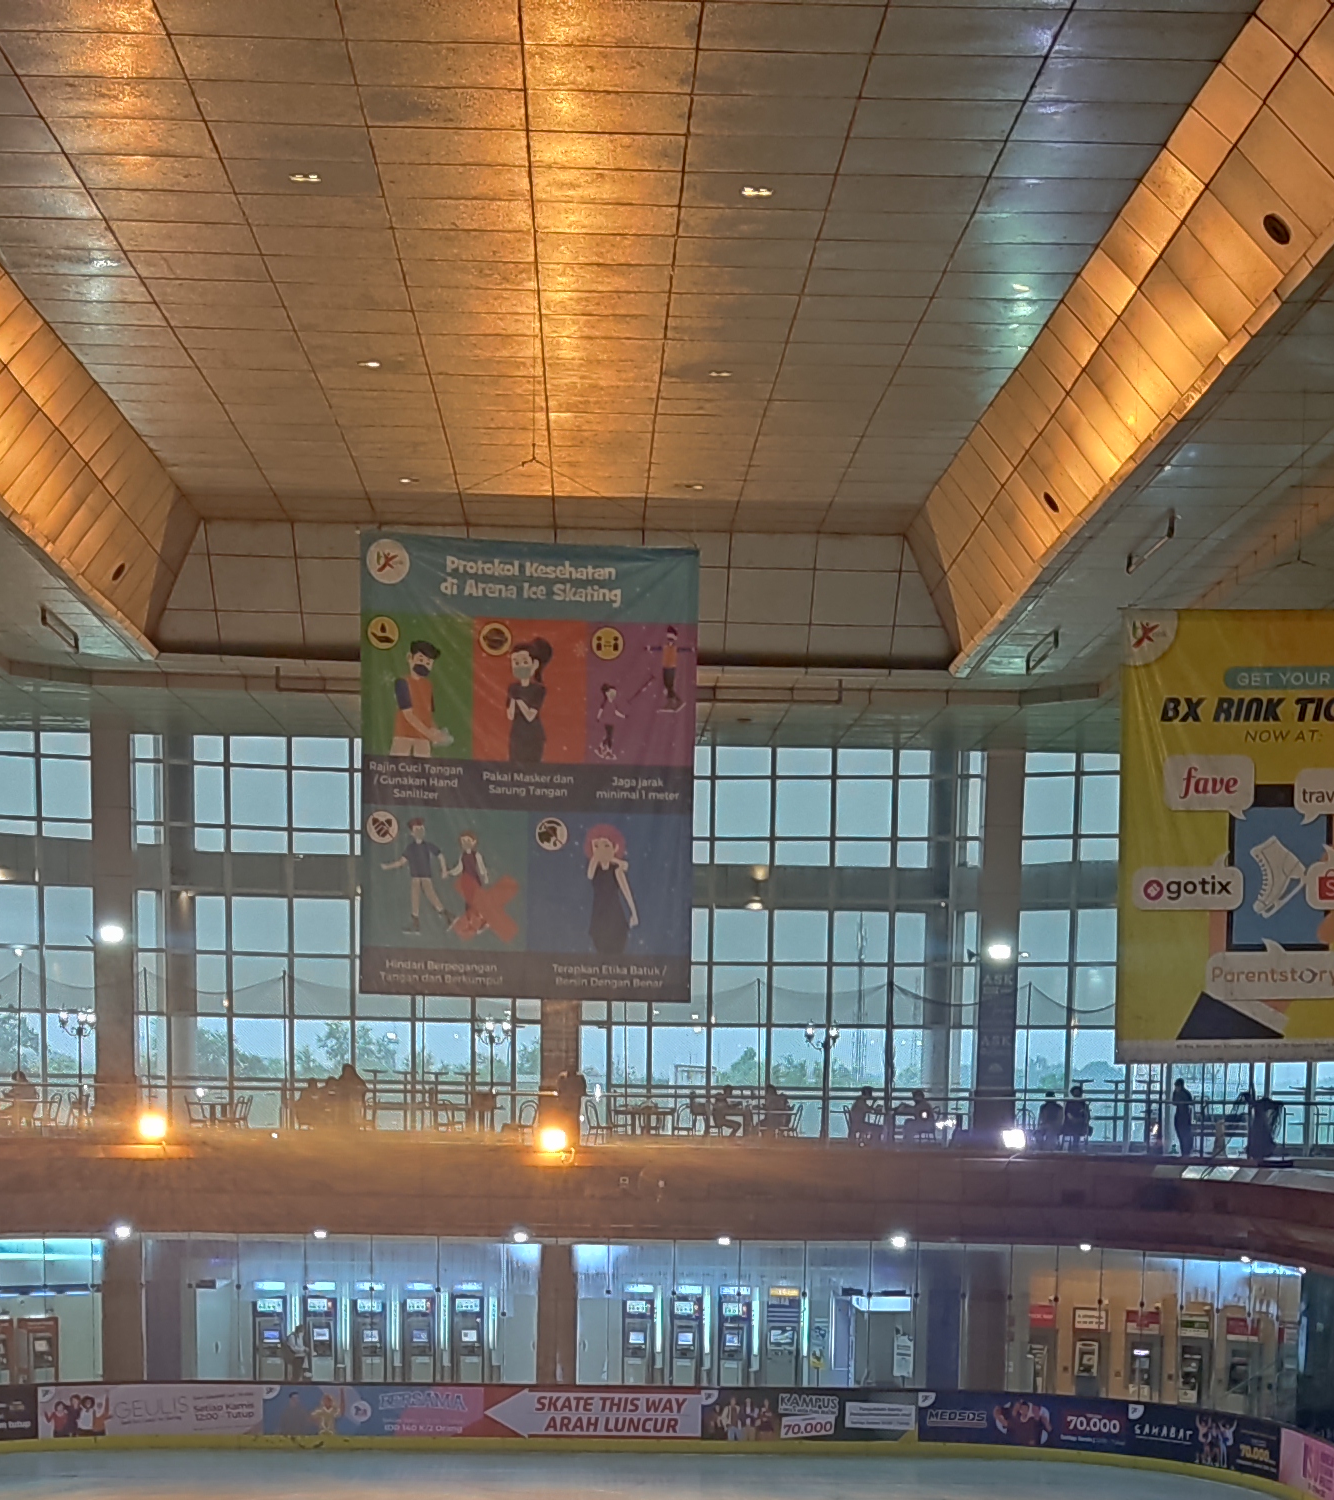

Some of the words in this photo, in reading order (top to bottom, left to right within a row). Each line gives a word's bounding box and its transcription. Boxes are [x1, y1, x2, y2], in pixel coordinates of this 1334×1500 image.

[445, 554, 520, 577] Protokol
[524, 561, 616, 580] Kesehatan
[440, 577, 458, 596] di
[464, 579, 517, 599] Arena
[523, 582, 546, 600] Ice
[552, 584, 622, 608] Skating
[1237, 672, 1274, 686] GET
[1279, 671, 1331, 686] YOUR
[1160, 695, 1207, 722] BX
[1212, 695, 1286, 722] RINK
[1244, 729, 1291, 743] NOW
[1294, 729, 1323, 742] AT:
[370, 761, 396, 775] Rajin
[398, 763, 421, 774] Cuci
[423, 764, 463, 777] Tangan
[429, 776, 459, 788] Hand
[483, 771, 512, 784] Pakai
[513, 773, 552, 784] Masker
[553, 774, 575, 784] dan
[611, 776, 637, 789] Jaga
[1179, 766, 1239, 800] fave
[392, 788, 439, 800] Sanitizer
[488, 785, 527, 798] Sarung
[528, 786, 568, 798] Tangan
[595, 788, 640, 800] minimal
[647, 790, 680, 801] meter
[1166, 875, 1232, 899] gotix
[114, 1396, 188, 1418] GEULIS
[535, 1395, 594, 1412] SKATE
[599, 1396, 641, 1413] THIS
[645, 1397, 688, 1414] WAY
[779, 1393, 838, 1409] KAMPUS
[545, 1415, 598, 1433] ARAH
[604, 1416, 679, 1434] LUNCUR
[783, 1421, 832, 1436] 70.000
[1067, 1415, 1120, 1434] 70.000
